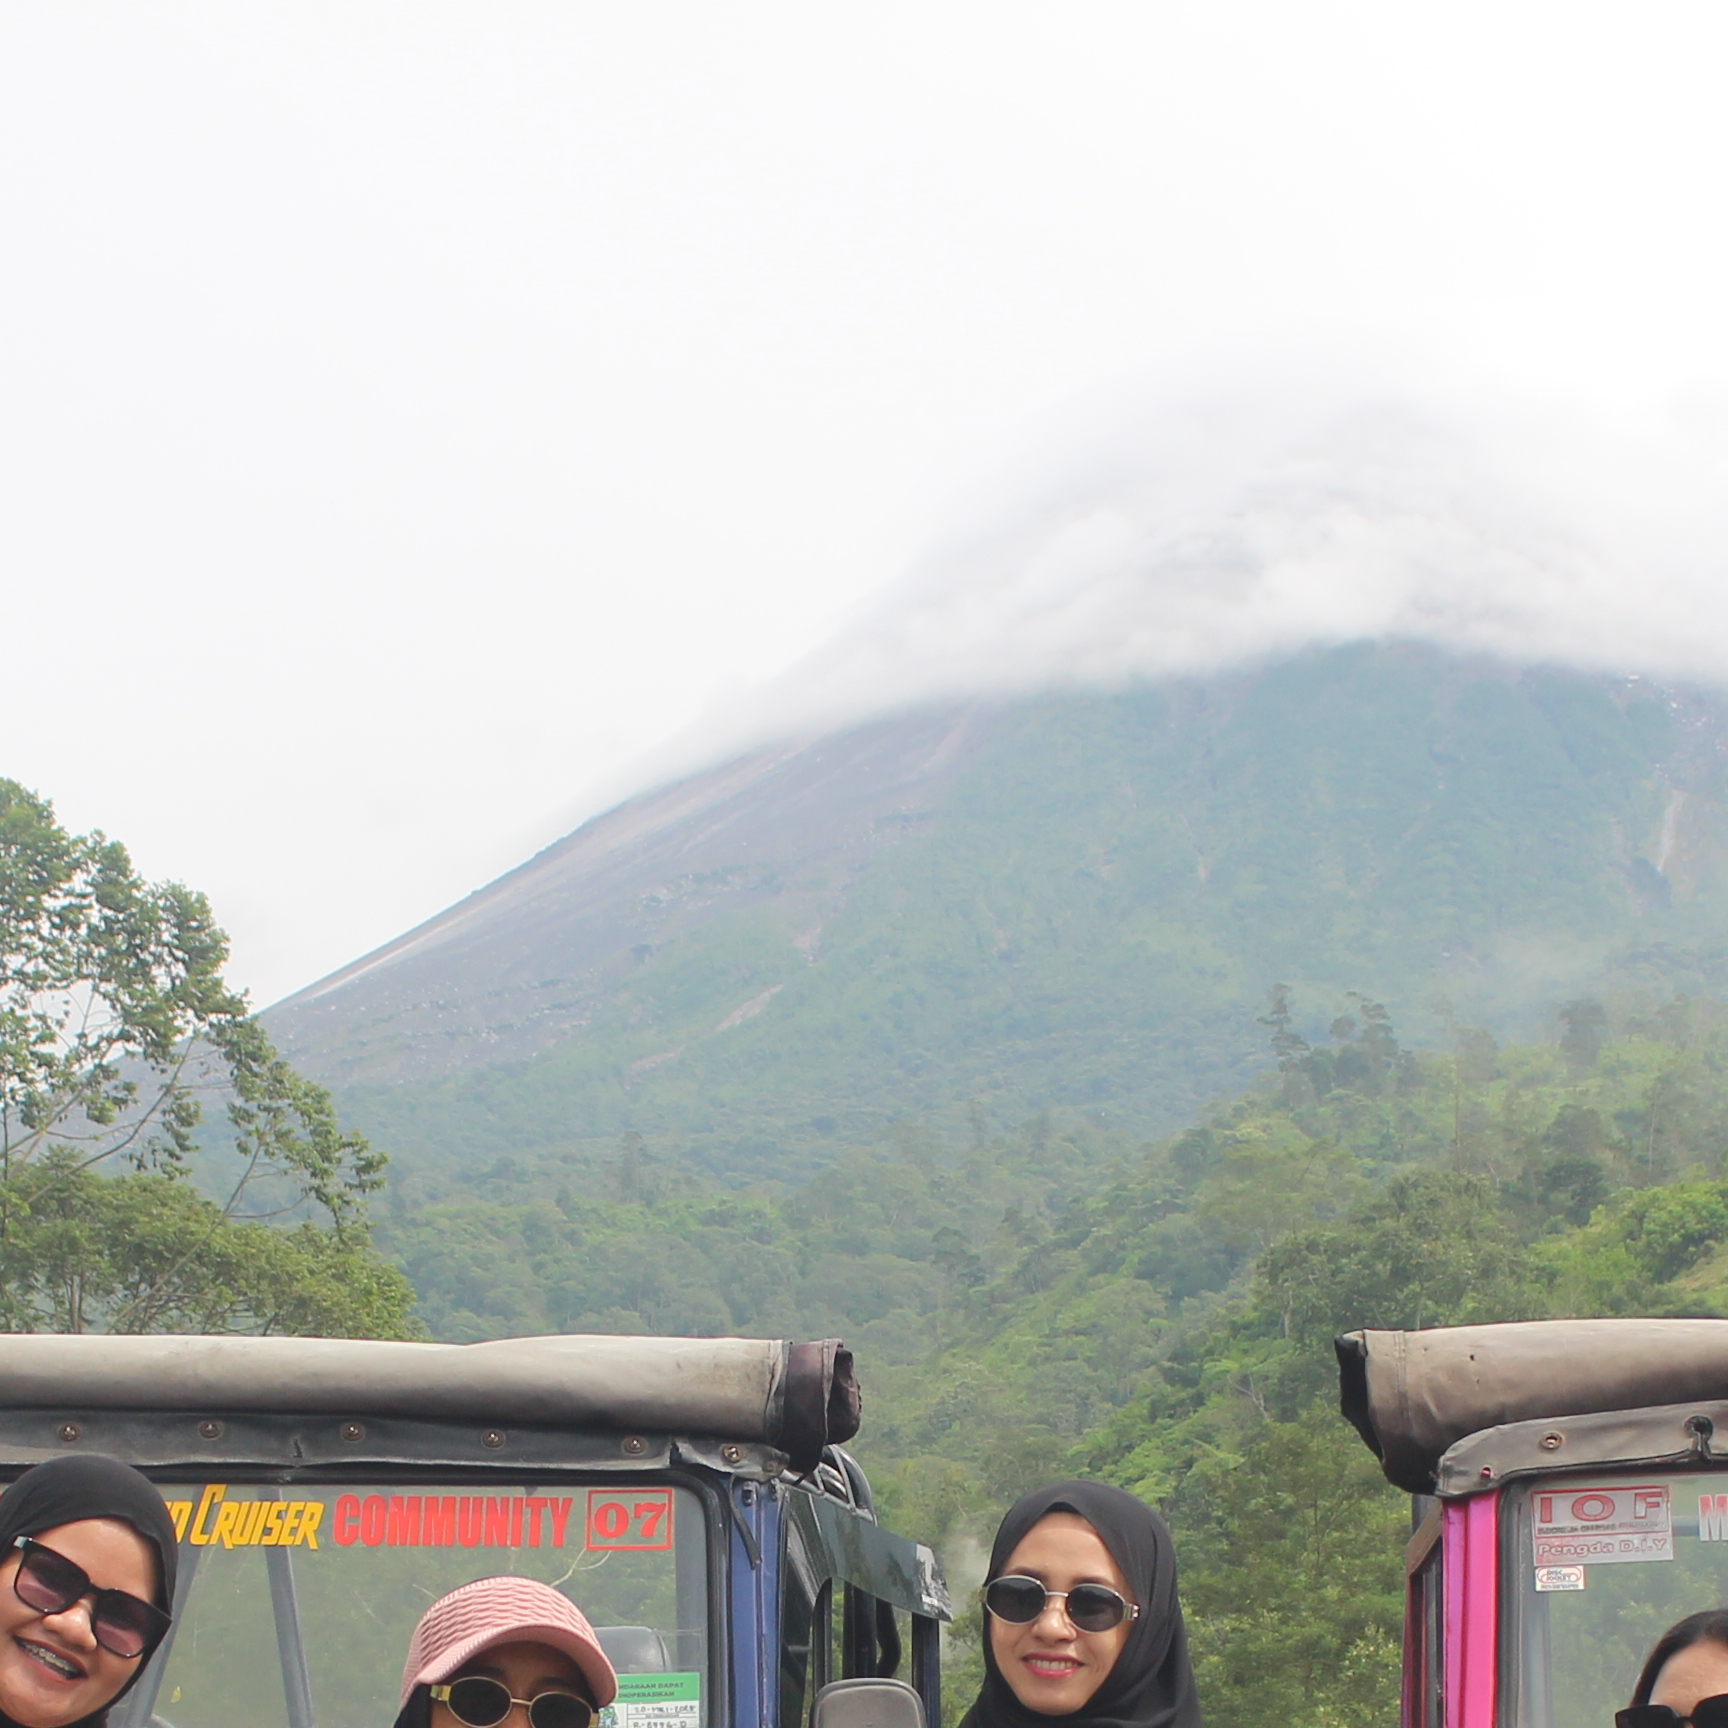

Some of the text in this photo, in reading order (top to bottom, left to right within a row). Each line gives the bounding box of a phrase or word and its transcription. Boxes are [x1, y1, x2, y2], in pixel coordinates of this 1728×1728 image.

[190, 1484, 325, 1550] CRUISER
[332, 1493, 573, 1548] COMMUNITY
[593, 1502, 667, 1539] 07
[1538, 1541, 1615, 1557] Pengda
